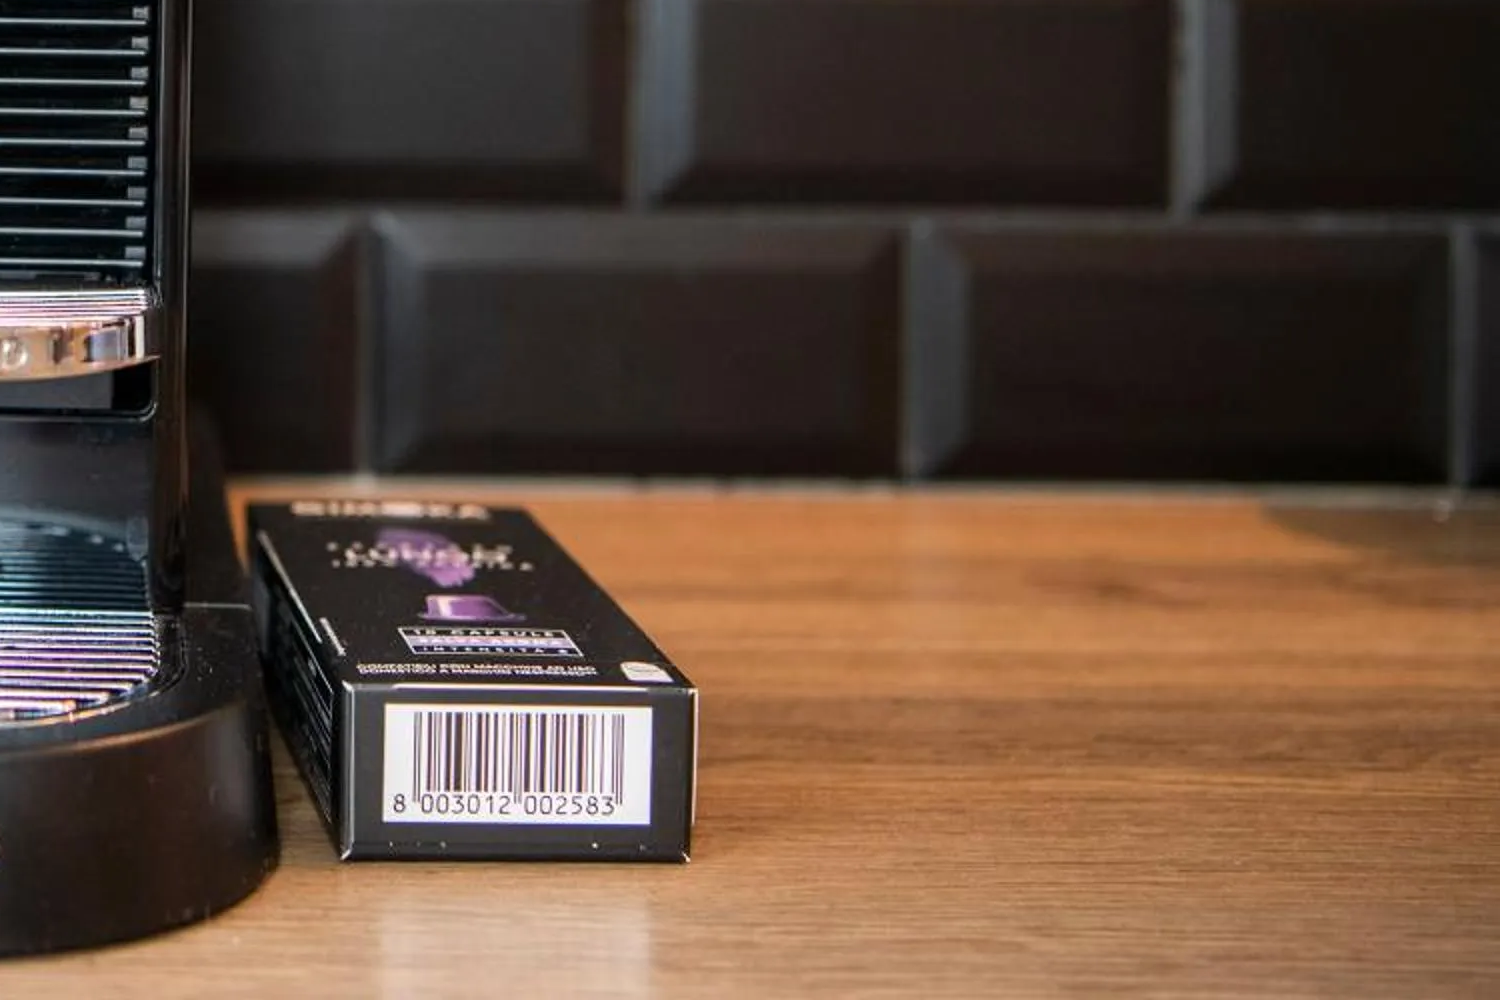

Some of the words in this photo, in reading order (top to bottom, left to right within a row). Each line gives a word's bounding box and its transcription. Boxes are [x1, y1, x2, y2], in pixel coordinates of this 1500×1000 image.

[393, 793, 406, 814] 8
[420, 794, 511, 815] 003012
[524, 795, 616, 815] 002583
